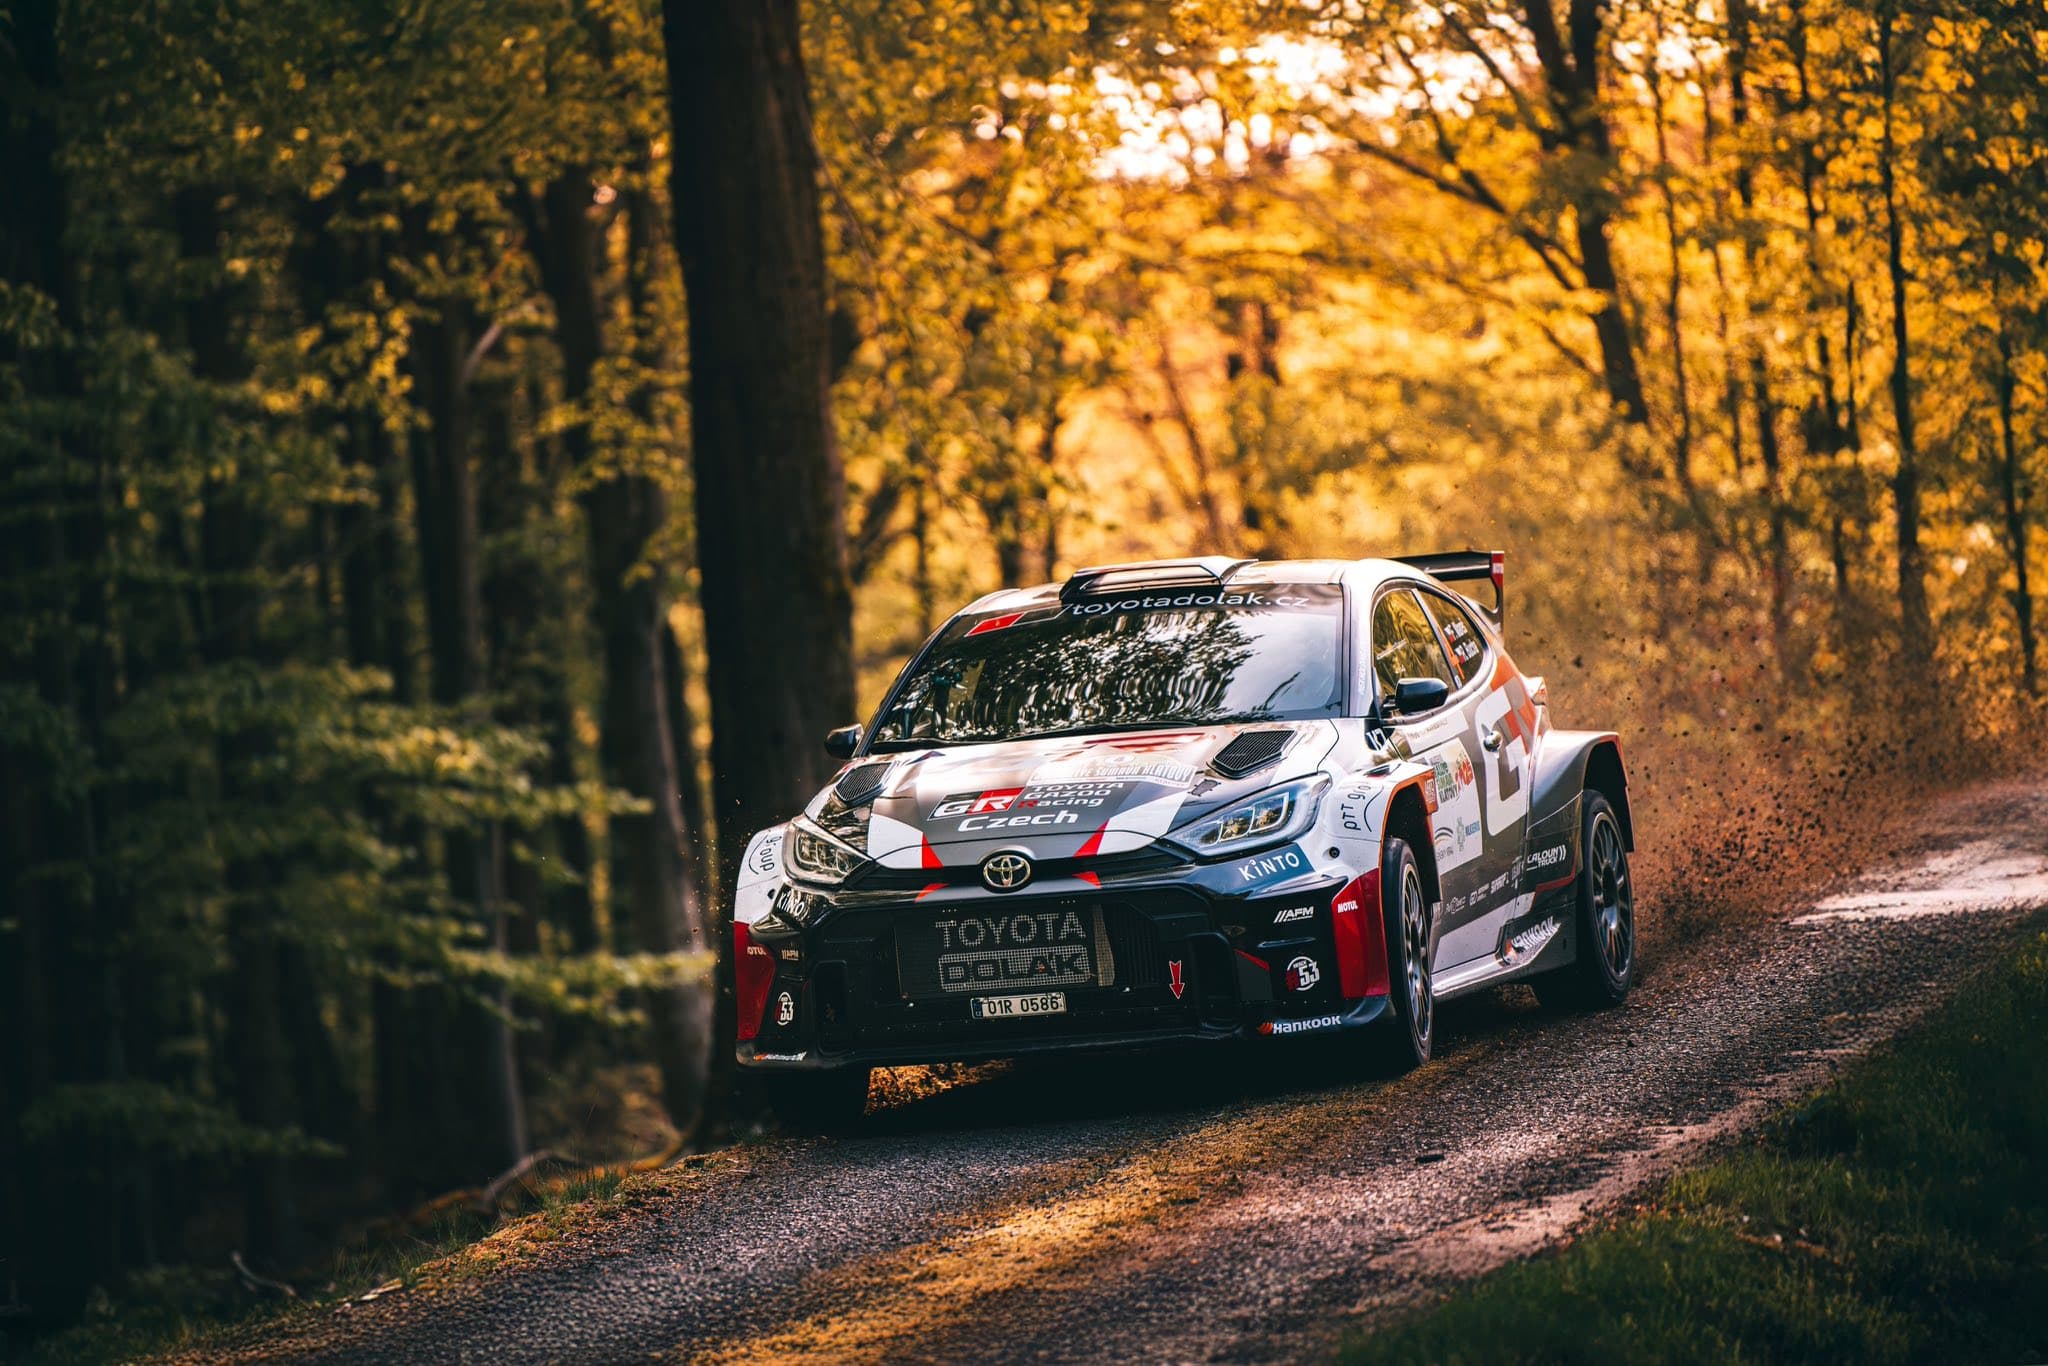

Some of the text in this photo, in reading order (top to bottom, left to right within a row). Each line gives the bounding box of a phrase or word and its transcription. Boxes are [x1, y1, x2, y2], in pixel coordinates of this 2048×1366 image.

[1072, 592, 1309, 615] toyotadolak.cz
[1031, 782, 1125, 792] TOYOTA
[1023, 789, 1112, 800] GAZOO
[933, 794, 1014, 818] GR
[1017, 797, 1105, 809] Racing
[957, 809, 1079, 832] Czech
[1337, 900, 1359, 913] MOTUL
[935, 912, 1087, 949] TOYOTA
[746, 946, 767, 956] OTUL
[1020, 996, 1060, 1012] 0586
